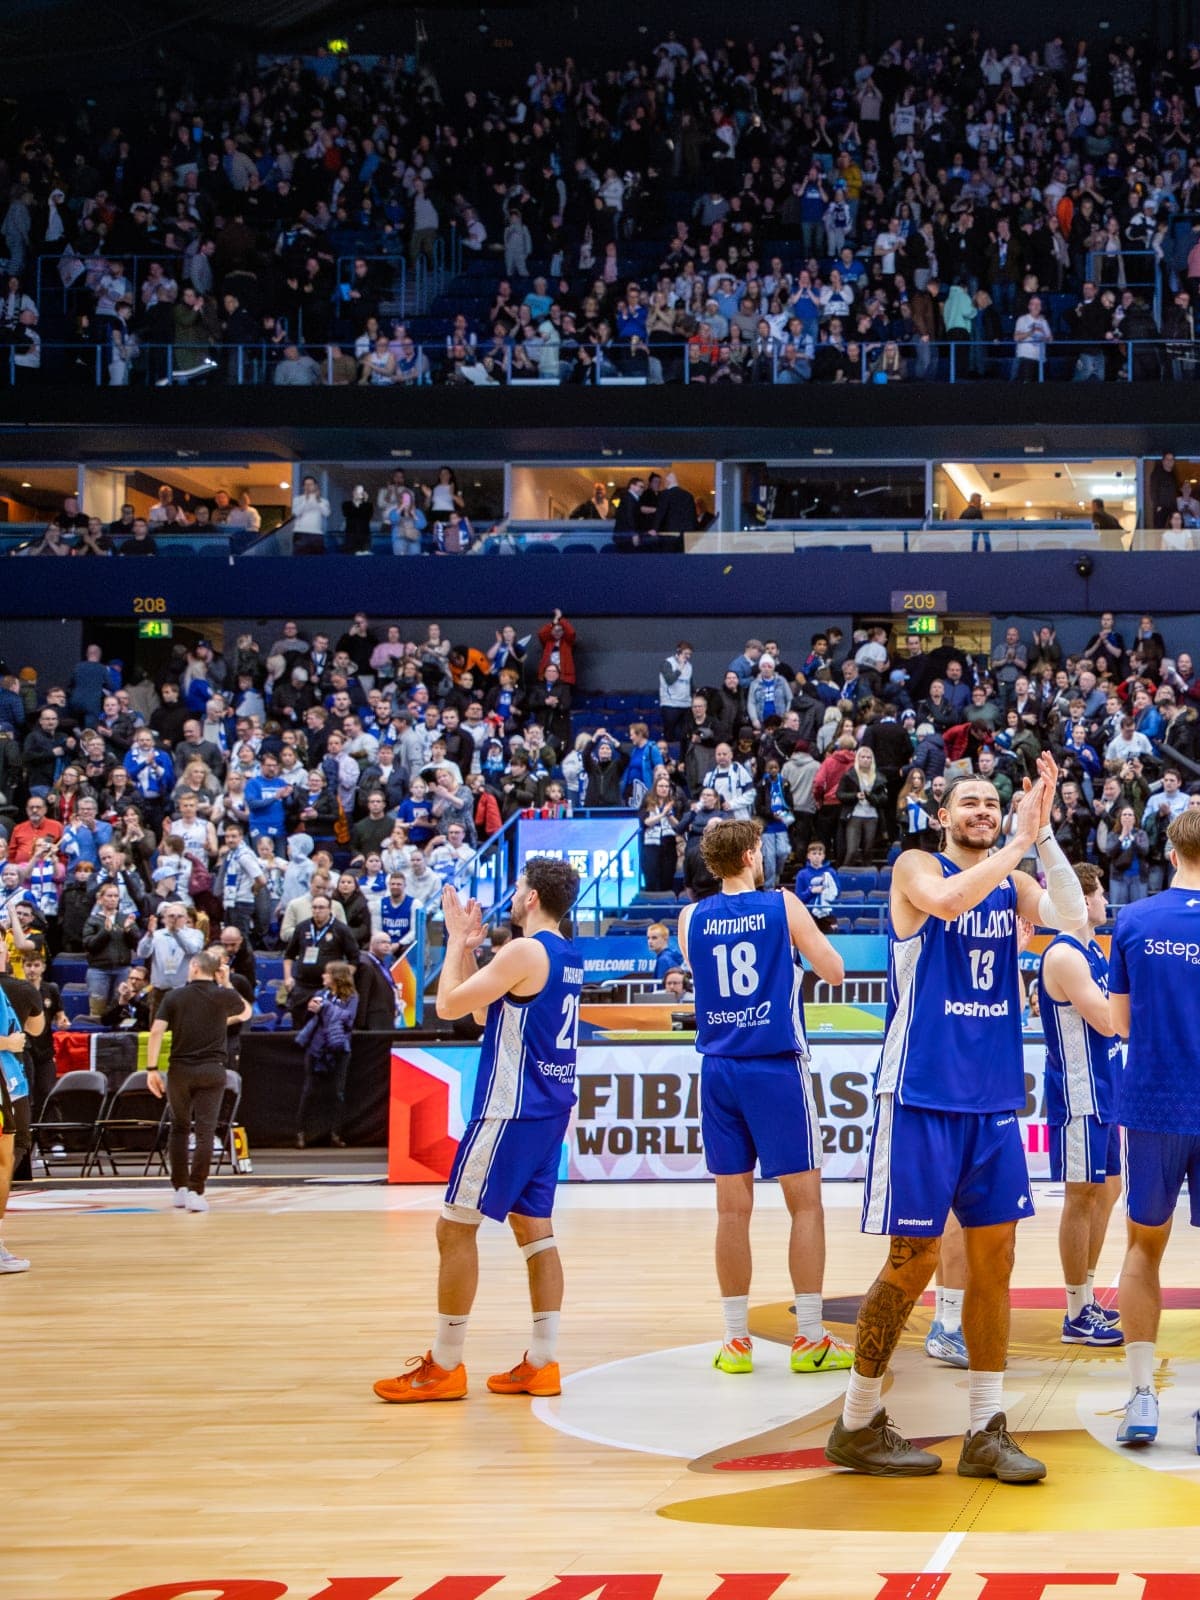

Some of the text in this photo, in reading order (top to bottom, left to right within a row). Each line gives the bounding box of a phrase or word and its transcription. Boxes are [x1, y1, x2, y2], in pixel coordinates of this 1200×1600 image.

[133, 597, 166, 613] 208
[904, 594, 935, 609] 209
[703, 913, 766, 935] JANTUNEN
[583, 959, 635, 971] WELCOME
[712, 941, 760, 998] 18
[969, 949, 995, 991] 13
